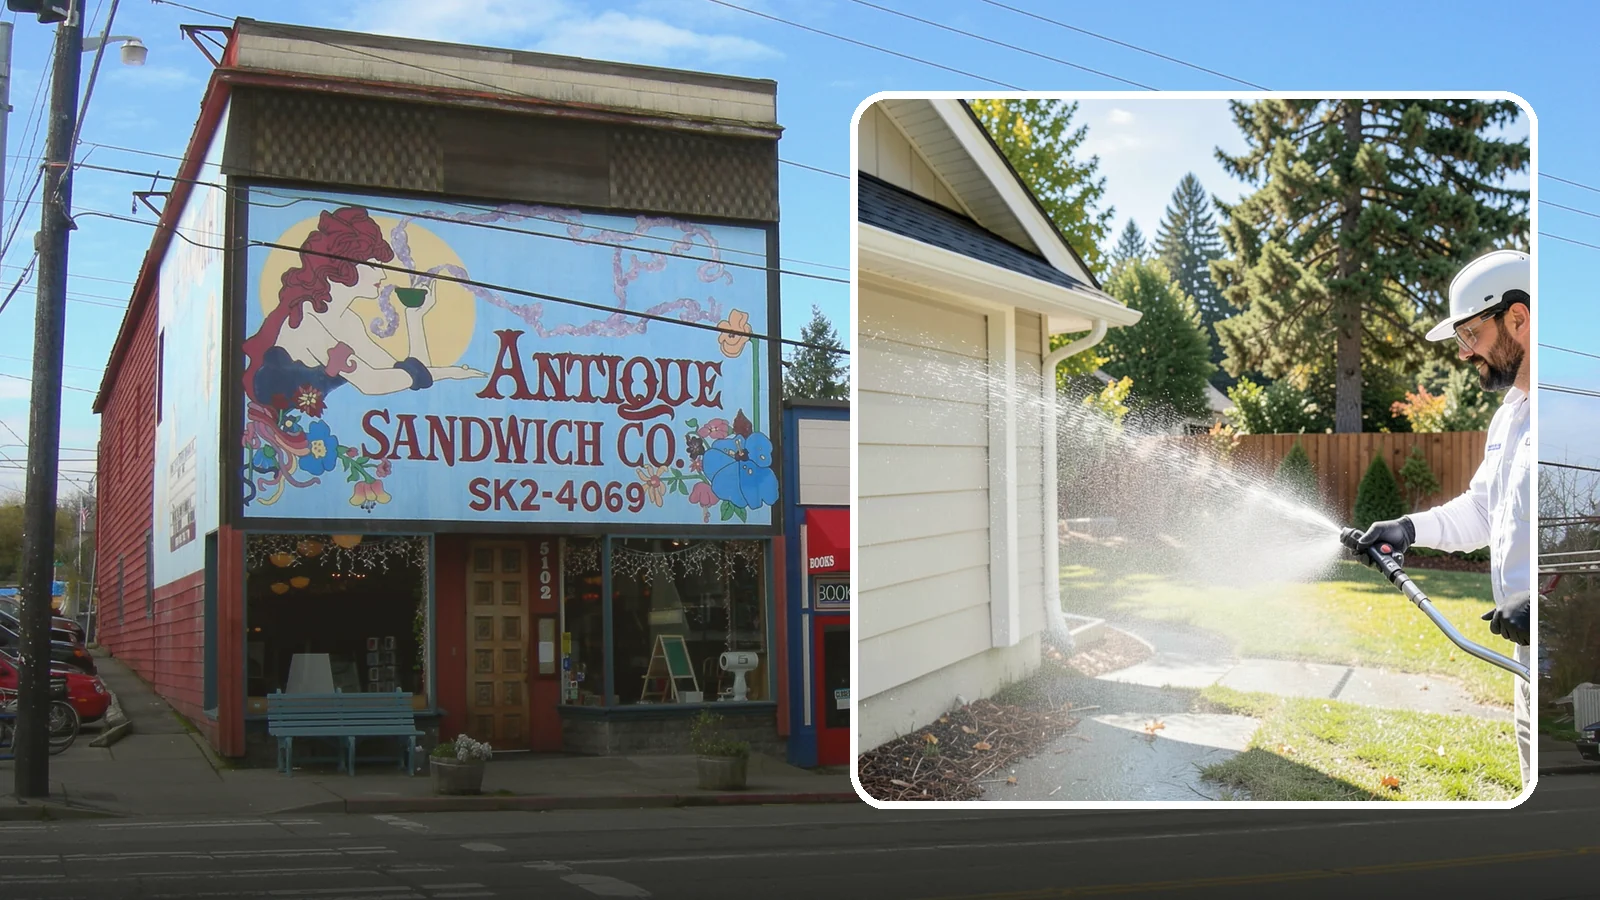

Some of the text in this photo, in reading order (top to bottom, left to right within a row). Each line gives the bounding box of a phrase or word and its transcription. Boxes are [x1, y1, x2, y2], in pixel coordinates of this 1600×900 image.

[476, 329, 723, 419] ANTIQUE
[361, 408, 686, 468] SANDWICH CO.
[467, 477, 647, 513] SK2-4069
[540, 541, 551, 600] 5102
[809, 555, 835, 569] BOOKS
